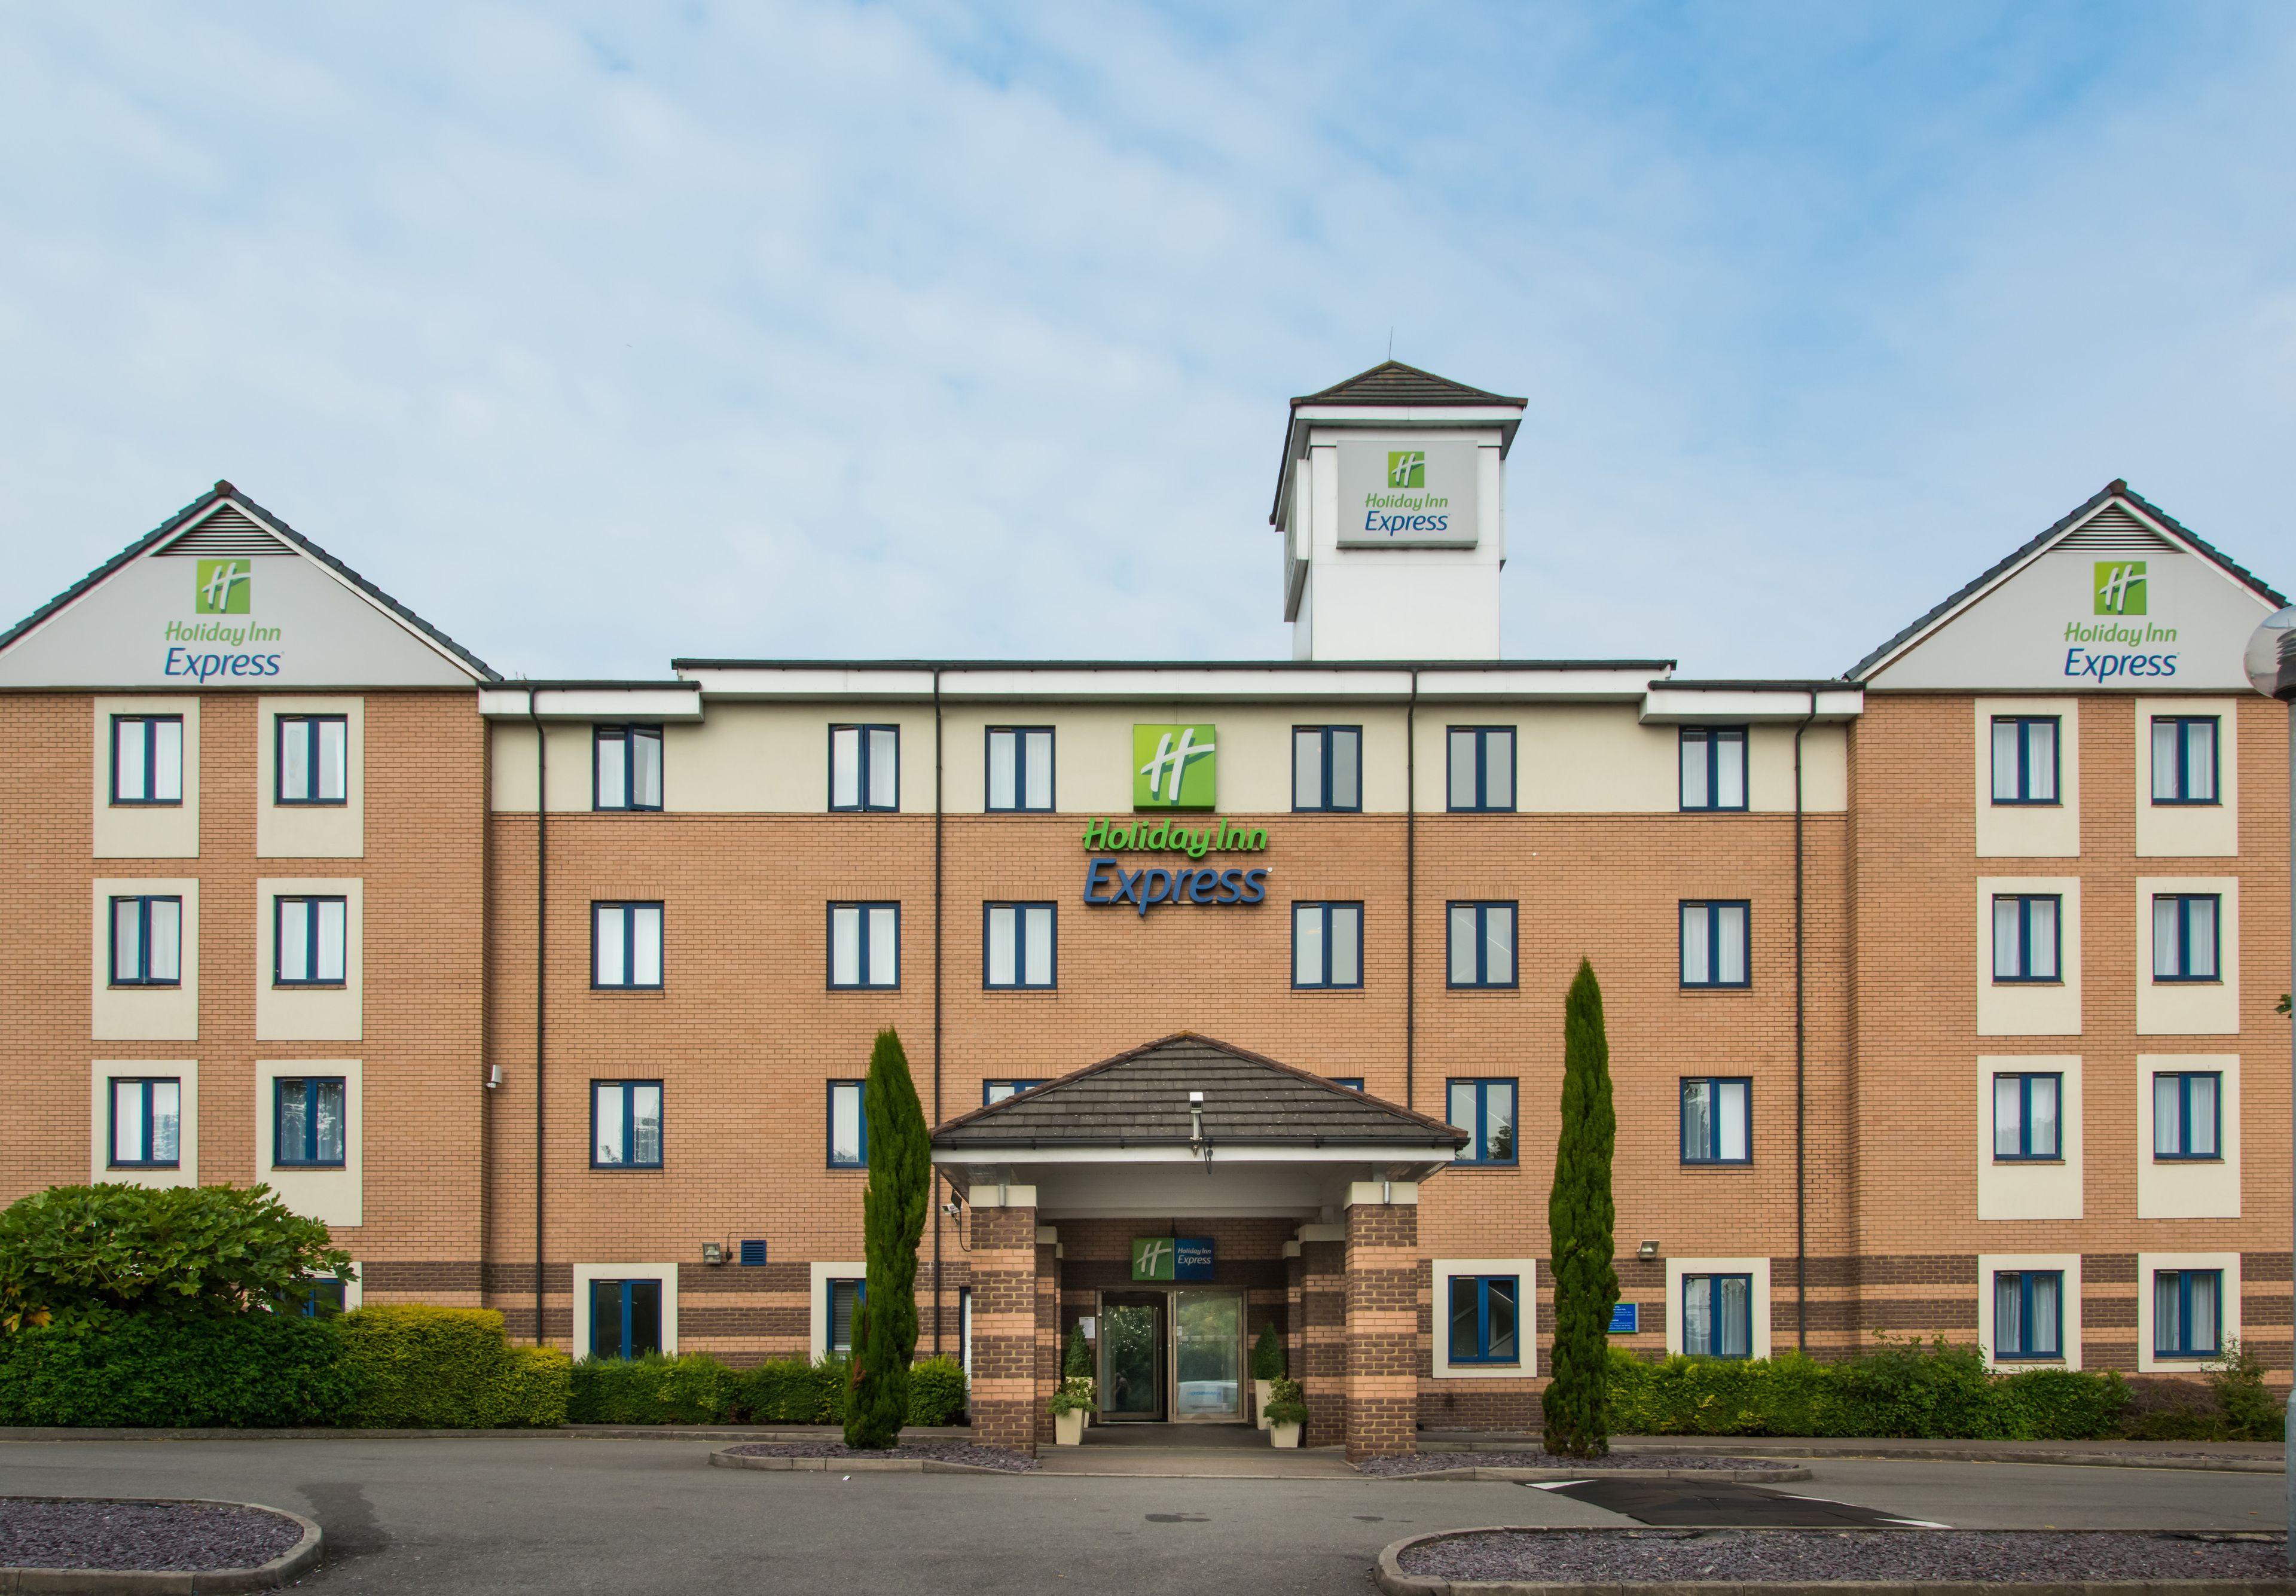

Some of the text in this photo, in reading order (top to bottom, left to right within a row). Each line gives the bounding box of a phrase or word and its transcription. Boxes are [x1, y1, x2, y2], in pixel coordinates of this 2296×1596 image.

[1365, 493, 1448, 511] Holiday Inn
[1365, 511, 1448, 536] Express
[164, 621, 282, 646] Holiday Inn
[2063, 622, 2177, 648] Holiday Inn
[164, 647, 282, 684] Express
[2064, 648, 2177, 684] Express
[1082, 817, 1268, 860] Holiday Inn
[1083, 858, 1268, 916] Express
[1177, 1255, 1211, 1265] Express
